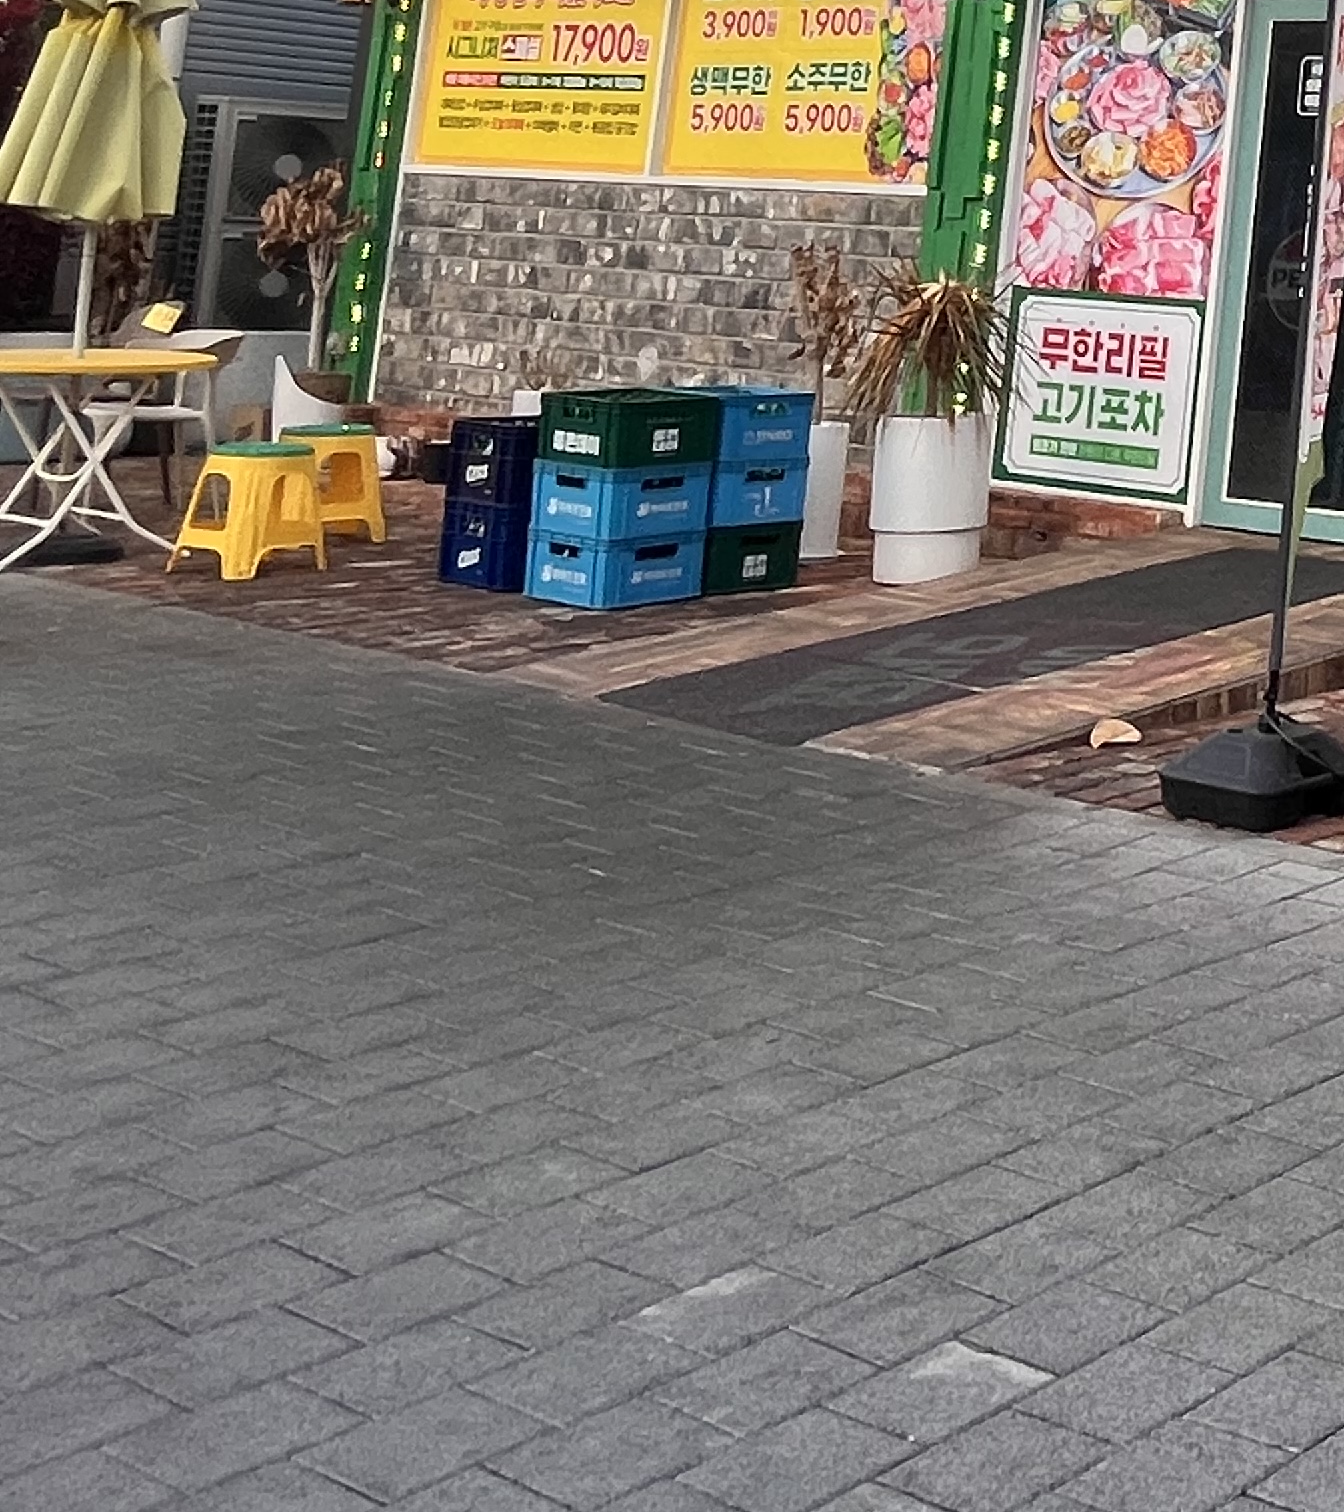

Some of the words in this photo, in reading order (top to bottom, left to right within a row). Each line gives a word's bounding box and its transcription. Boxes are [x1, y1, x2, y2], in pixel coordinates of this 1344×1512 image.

[786, 61, 872, 92] 소주무한
[1041, 326, 1169, 381] 무한리필
[1032, 381, 1165, 436] 고기포차
